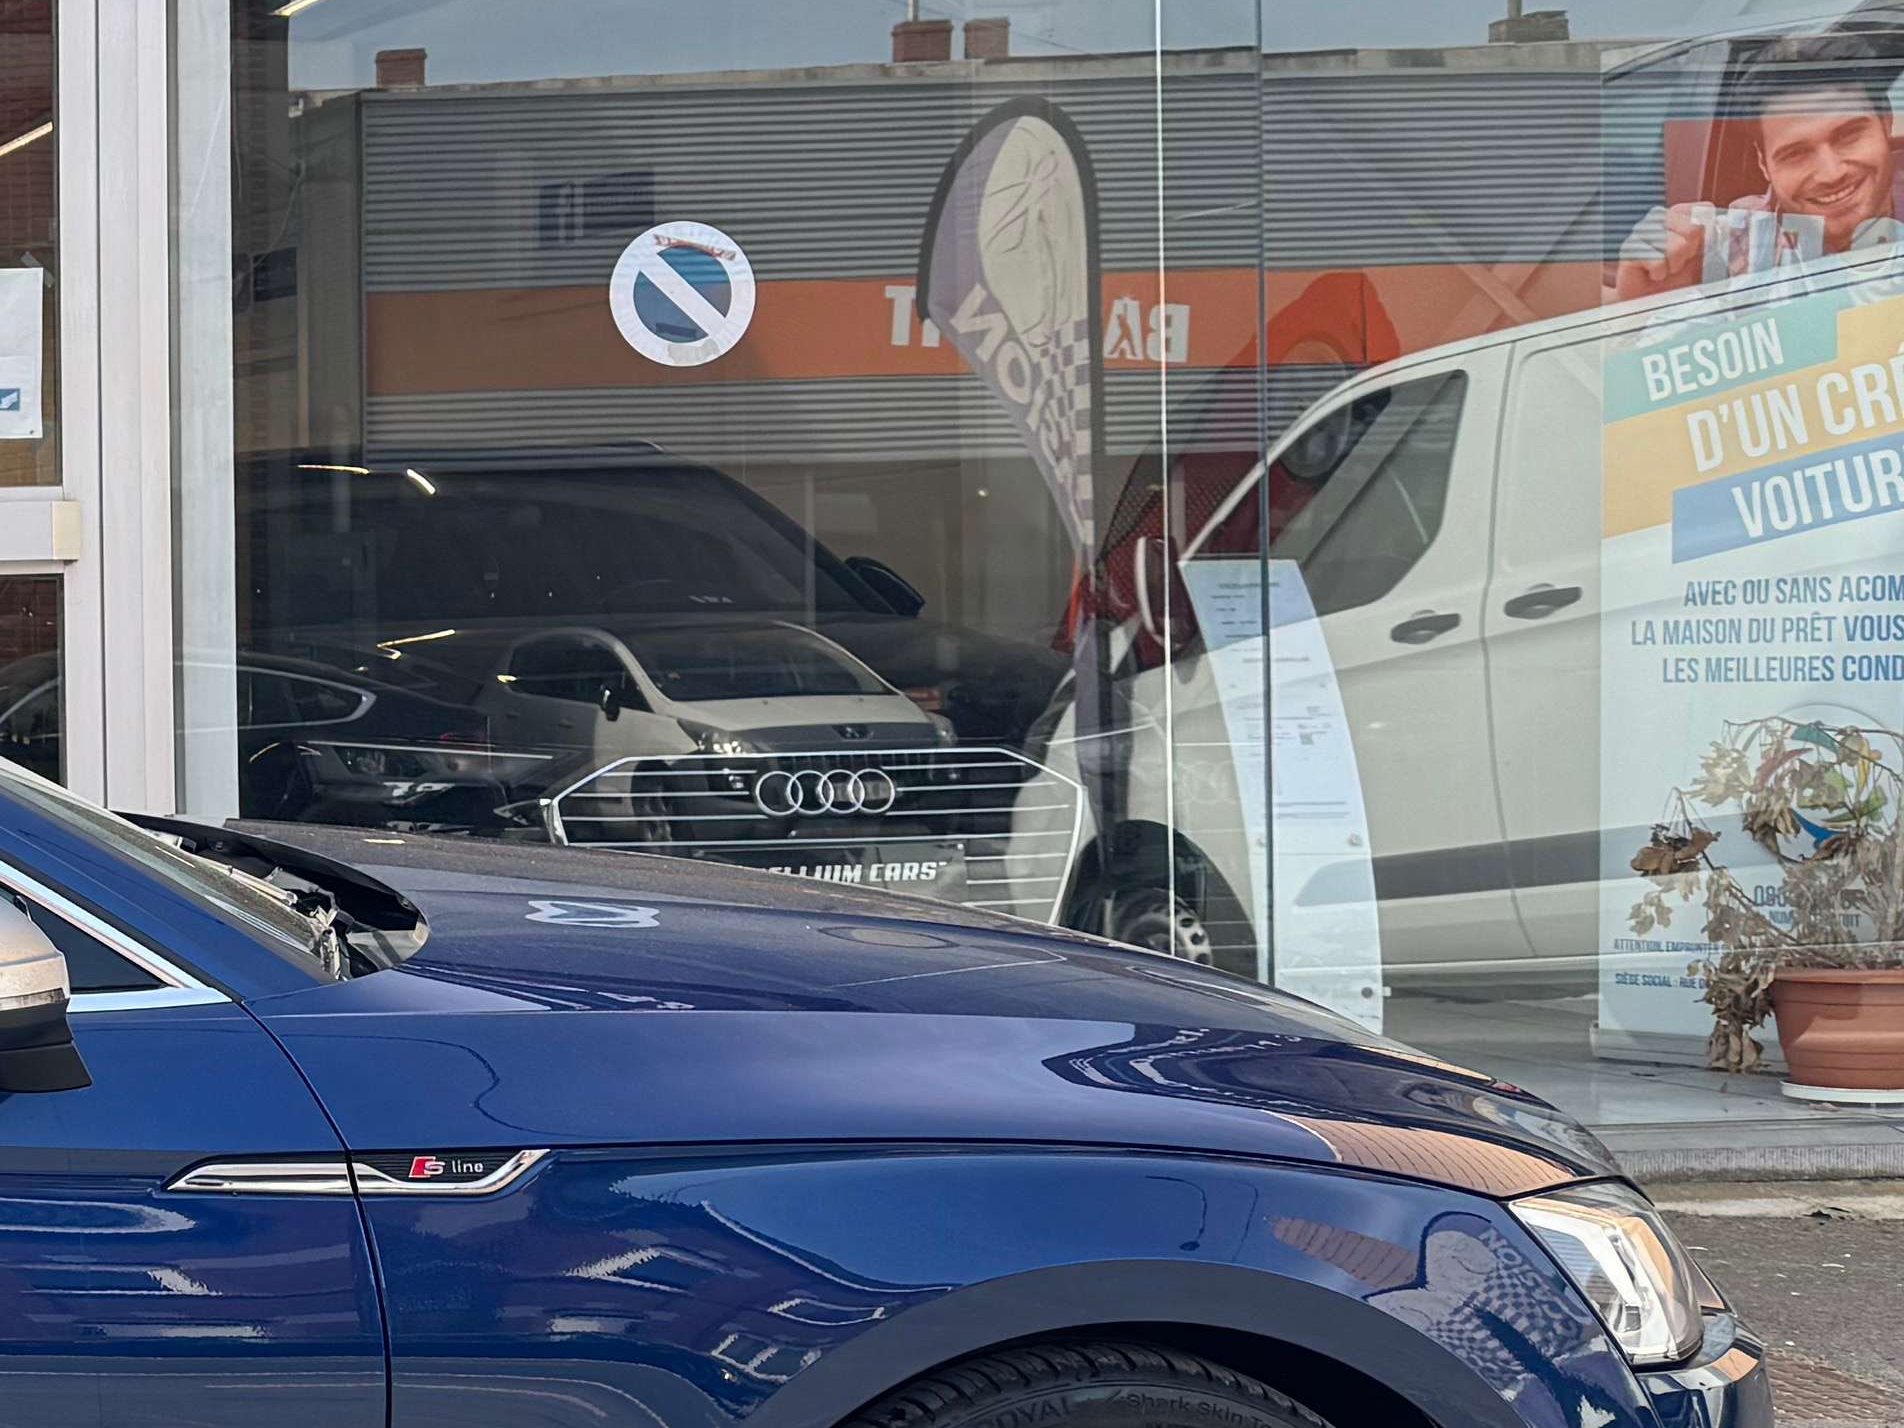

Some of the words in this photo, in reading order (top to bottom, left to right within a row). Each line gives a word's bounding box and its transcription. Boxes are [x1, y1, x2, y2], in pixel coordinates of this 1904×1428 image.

[1641, 316, 1785, 403] BESOIN
[1686, 383, 1810, 473] D'UN
[1732, 444, 1904, 542] VOITUR
[1683, 579, 1737, 607] AVEC
[1742, 578, 1770, 605] OU
[1775, 576, 1832, 604] SANS
[1631, 619, 1657, 646] LA
[1662, 617, 1742, 645] MAISON
[1748, 617, 1775, 643] DU
[1781, 611, 1837, 643] PRÊT
[1843, 614, 1904, 642] VOUS
[1662, 657, 1699, 683] LES
[1705, 655, 1835, 683] MEILLEURES
[869, 861, 938, 882] CARS
[452, 1158, 484, 1174] line
[1127, 1392, 1191, 1412] Shark
[1198, 1401, 1243, 1425] Skin
